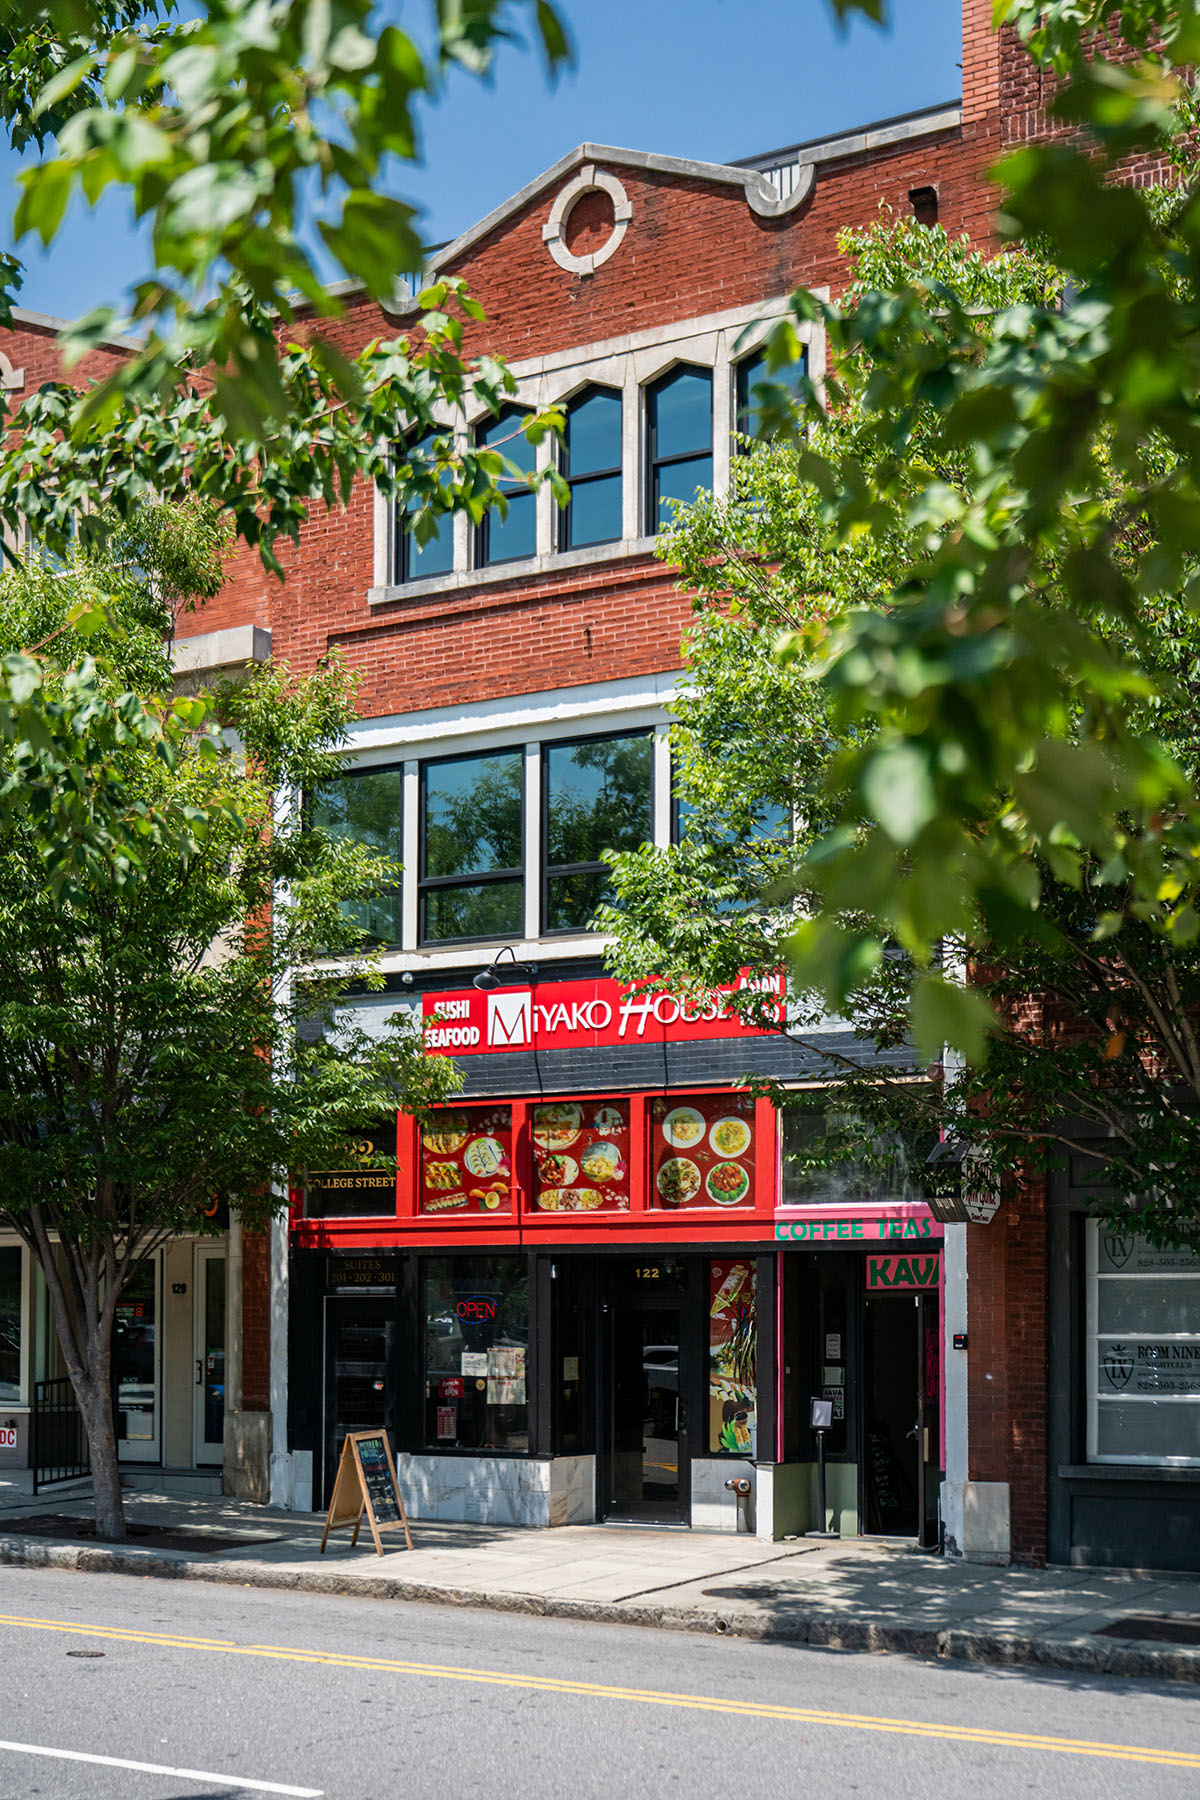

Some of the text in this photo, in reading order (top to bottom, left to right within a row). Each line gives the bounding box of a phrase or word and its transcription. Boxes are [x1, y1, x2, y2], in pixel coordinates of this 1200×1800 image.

[434, 1000, 470, 1020] SUSHI
[424, 1026, 480, 1048] SEAFOOD
[355, 1177, 396, 1187] STREET
[775, 1217, 931, 1241] COFFEE TEAS
[343, 1260, 381, 1270] SUITES
[353, 1272, 372, 1282] 202
[378, 1272, 395, 1282] 301
[635, 1268, 660, 1278] 122
[172, 1283, 187, 1294] 120
[456, 1302, 496, 1318] OPEN
[1137, 1345, 1200, 1359] ROOM NINE
